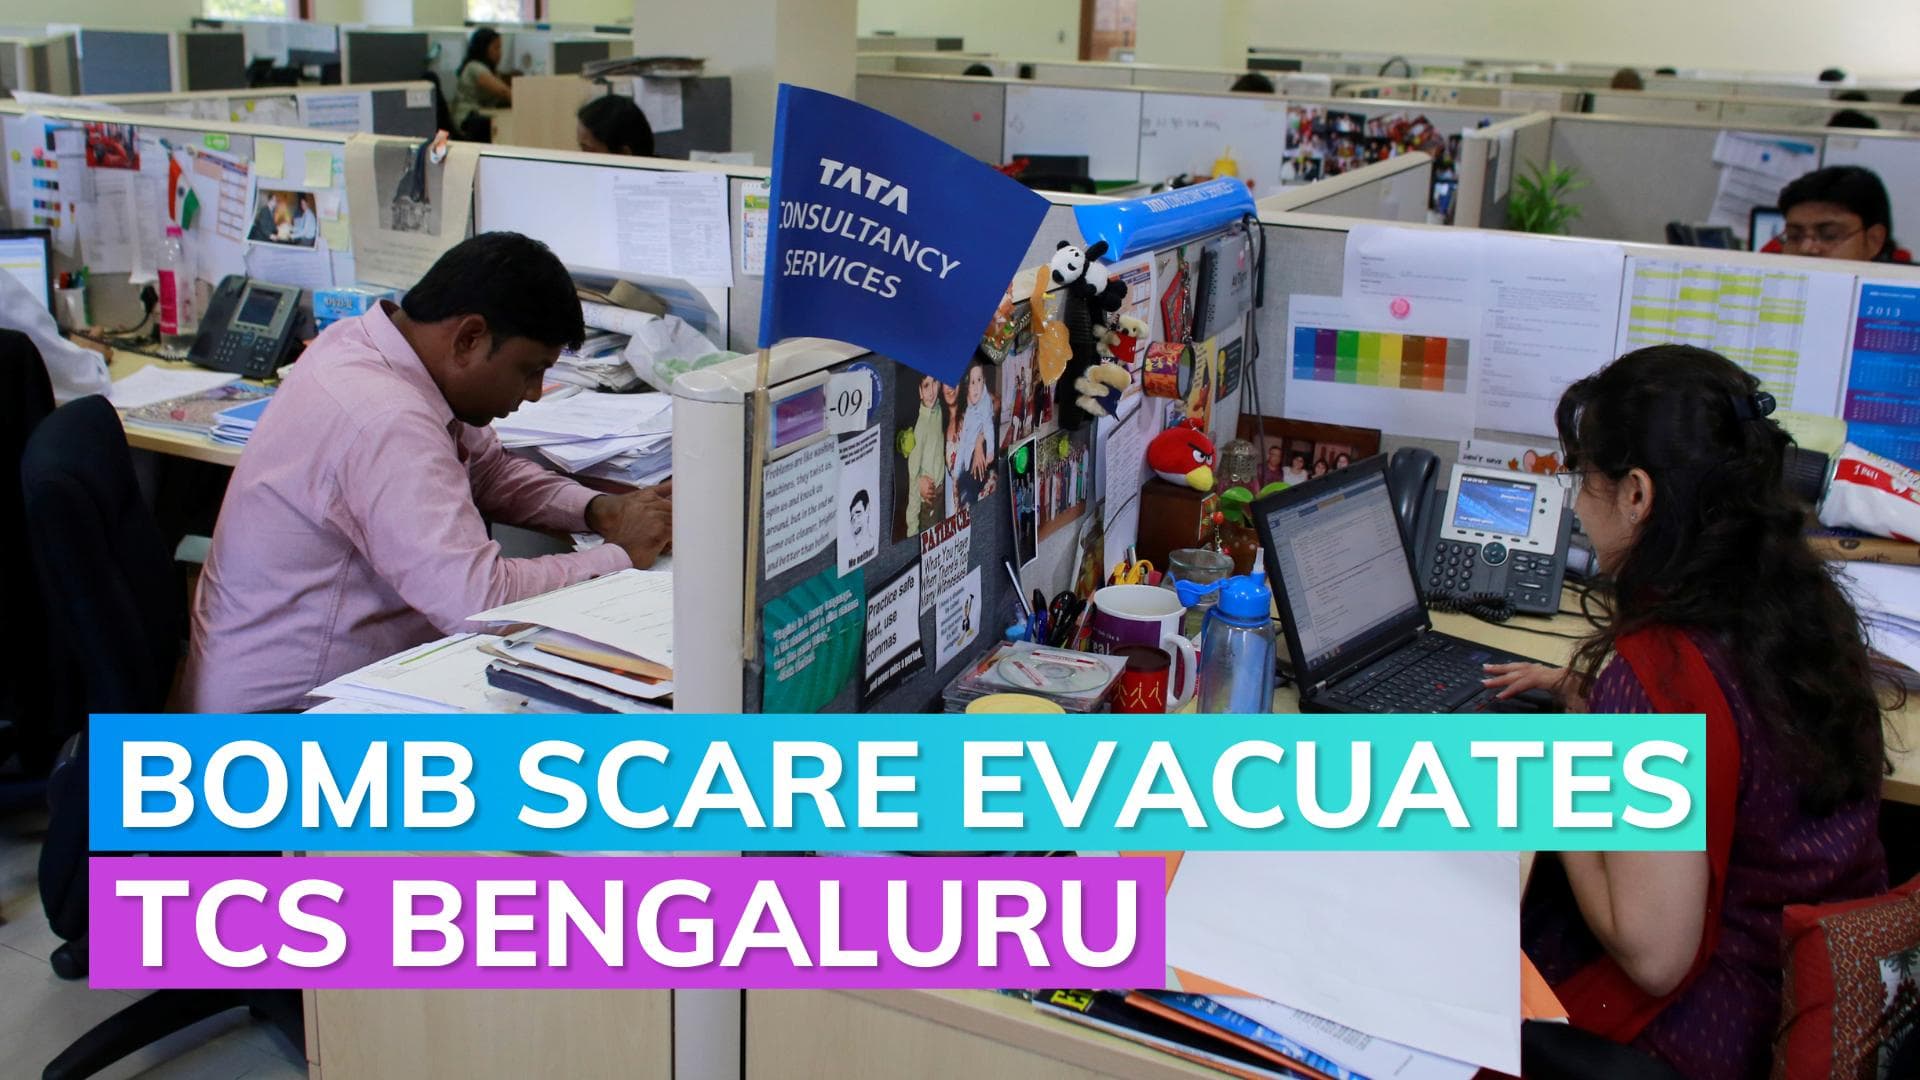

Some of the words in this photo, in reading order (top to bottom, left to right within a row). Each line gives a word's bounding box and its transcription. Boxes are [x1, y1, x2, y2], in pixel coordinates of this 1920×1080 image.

[819, 157, 909, 216] TATA
[783, 249, 902, 299] SERVICES
[1866, 305, 1901, 318] 2013
[829, 389, 863, 417] -09
[924, 552, 941, 574] What
[942, 545, 954, 561] You
[955, 536, 969, 555] Have
[868, 589, 898, 620] Practice
[898, 575, 915, 597] safe
[884, 610, 898, 629] use
[866, 631, 897, 666] commas
